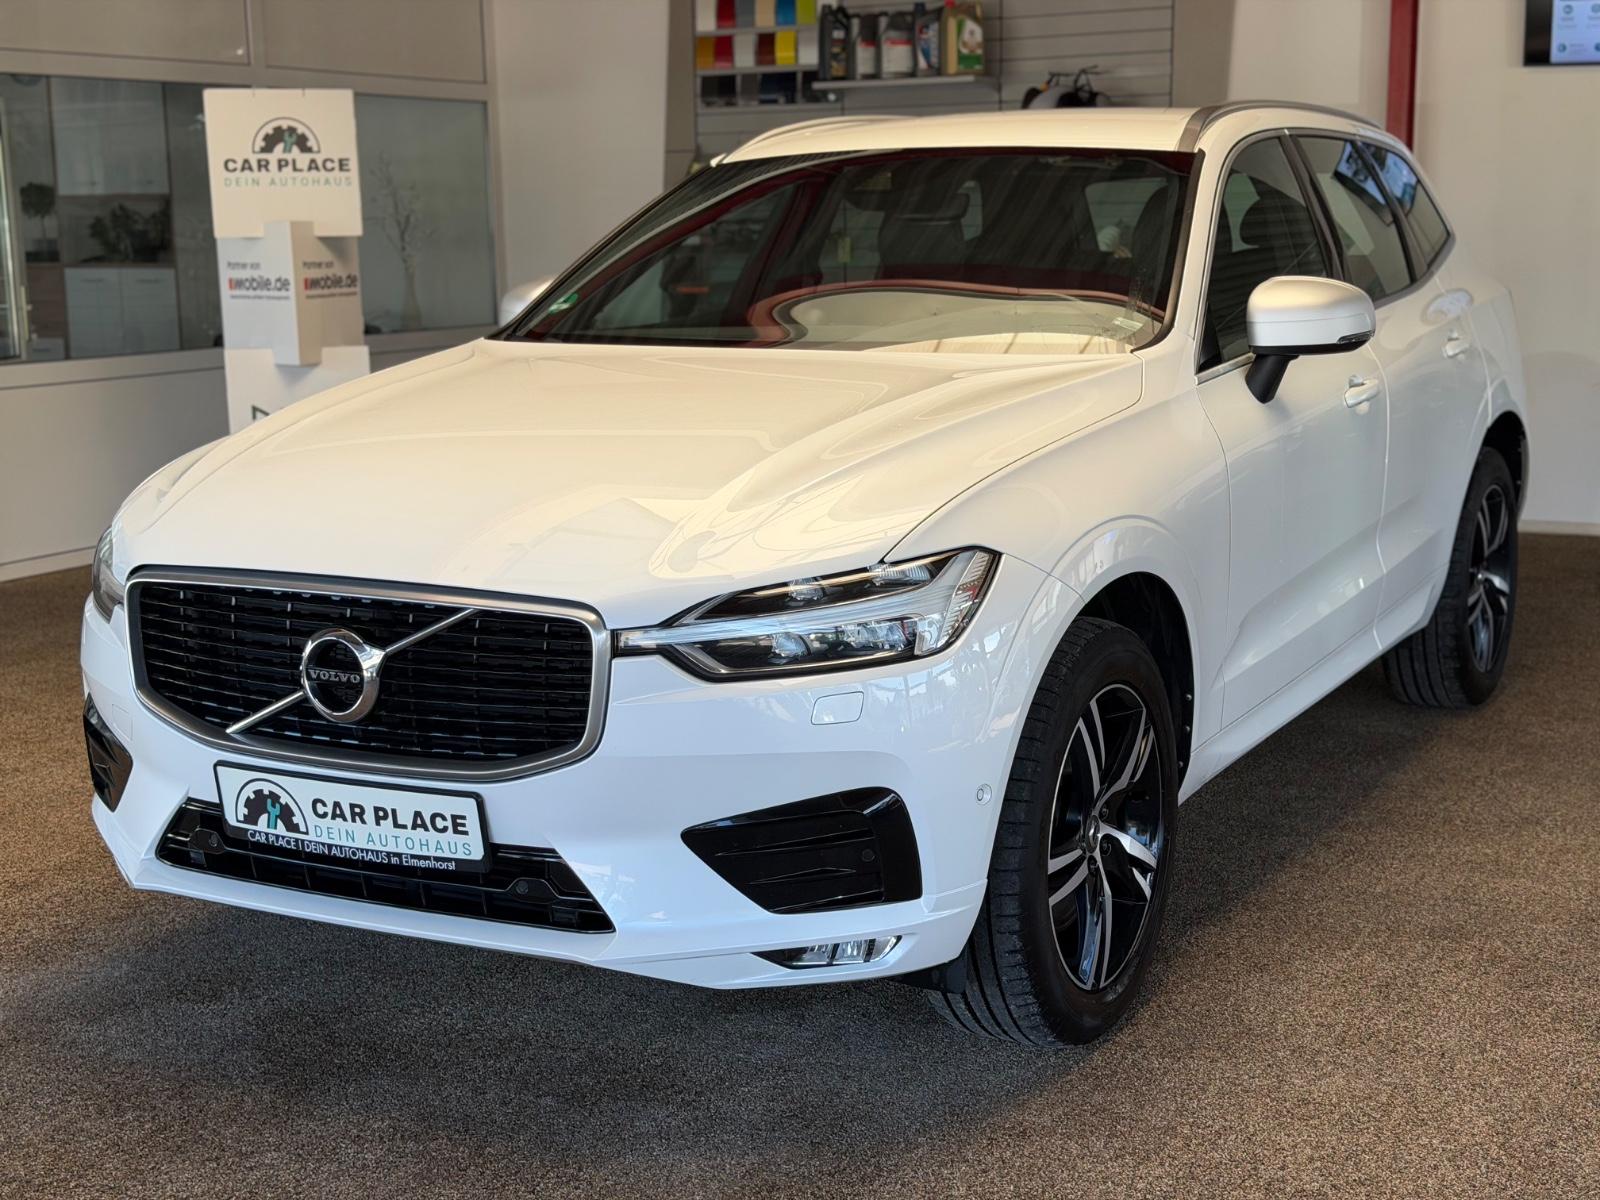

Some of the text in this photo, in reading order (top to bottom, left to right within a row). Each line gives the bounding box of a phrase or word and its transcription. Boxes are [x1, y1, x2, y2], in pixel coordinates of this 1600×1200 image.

[224, 158, 351, 173] CAR PLACE
[224, 176, 352, 187] DEIN AUTOHAUS
[308, 669, 360, 683] VOLVO
[311, 798, 469, 836] CAR PLACE
[247, 830, 267, 843] CAR
[268, 833, 297, 850] PLACE
[304, 841, 329, 854] DEIN
[330, 844, 388, 864] AUTOHAUS
[390, 854, 400, 865] in
[402, 855, 456, 871] Elmenhorst
[314, 825, 472, 856] DEIN AUTOHAUS
